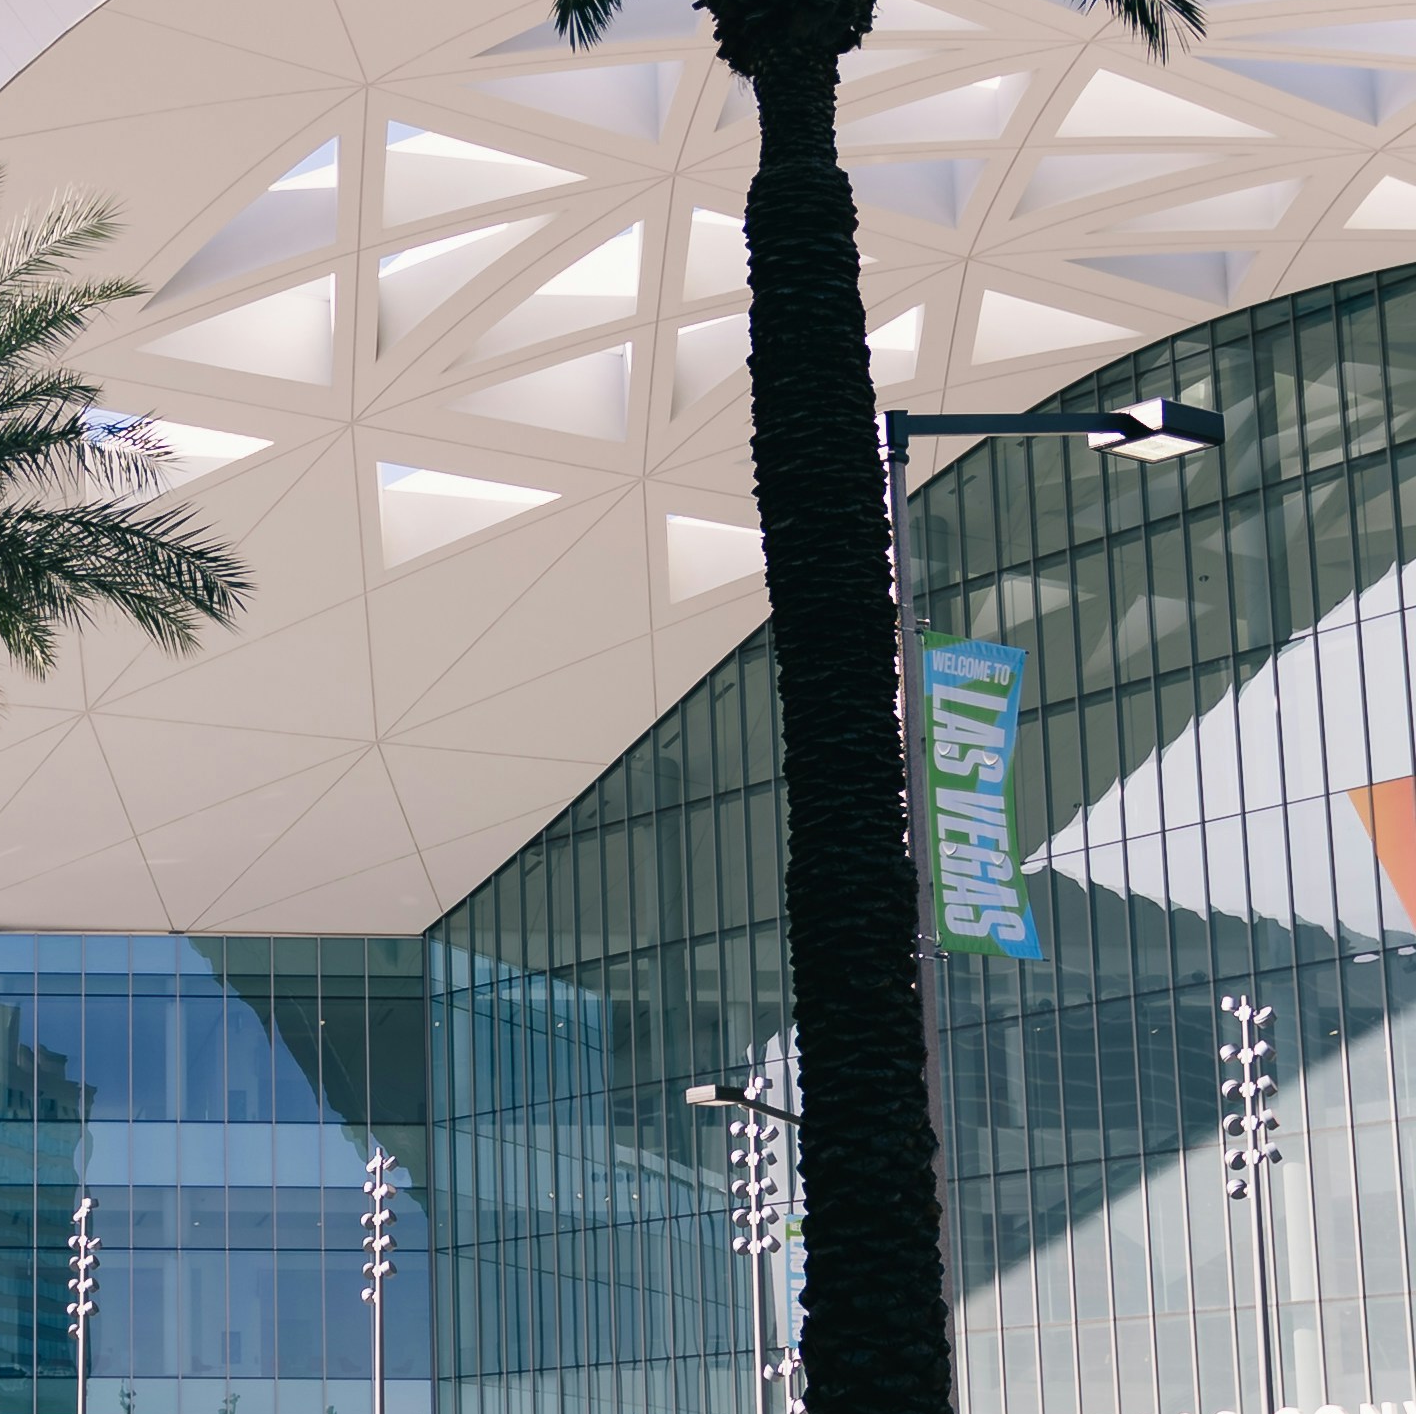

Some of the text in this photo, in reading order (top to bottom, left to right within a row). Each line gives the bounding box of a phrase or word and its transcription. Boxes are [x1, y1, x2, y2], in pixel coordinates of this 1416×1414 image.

[932, 649, 1011, 686] WELCOME TO
[932, 683, 1026, 941] LAS VEGAS
